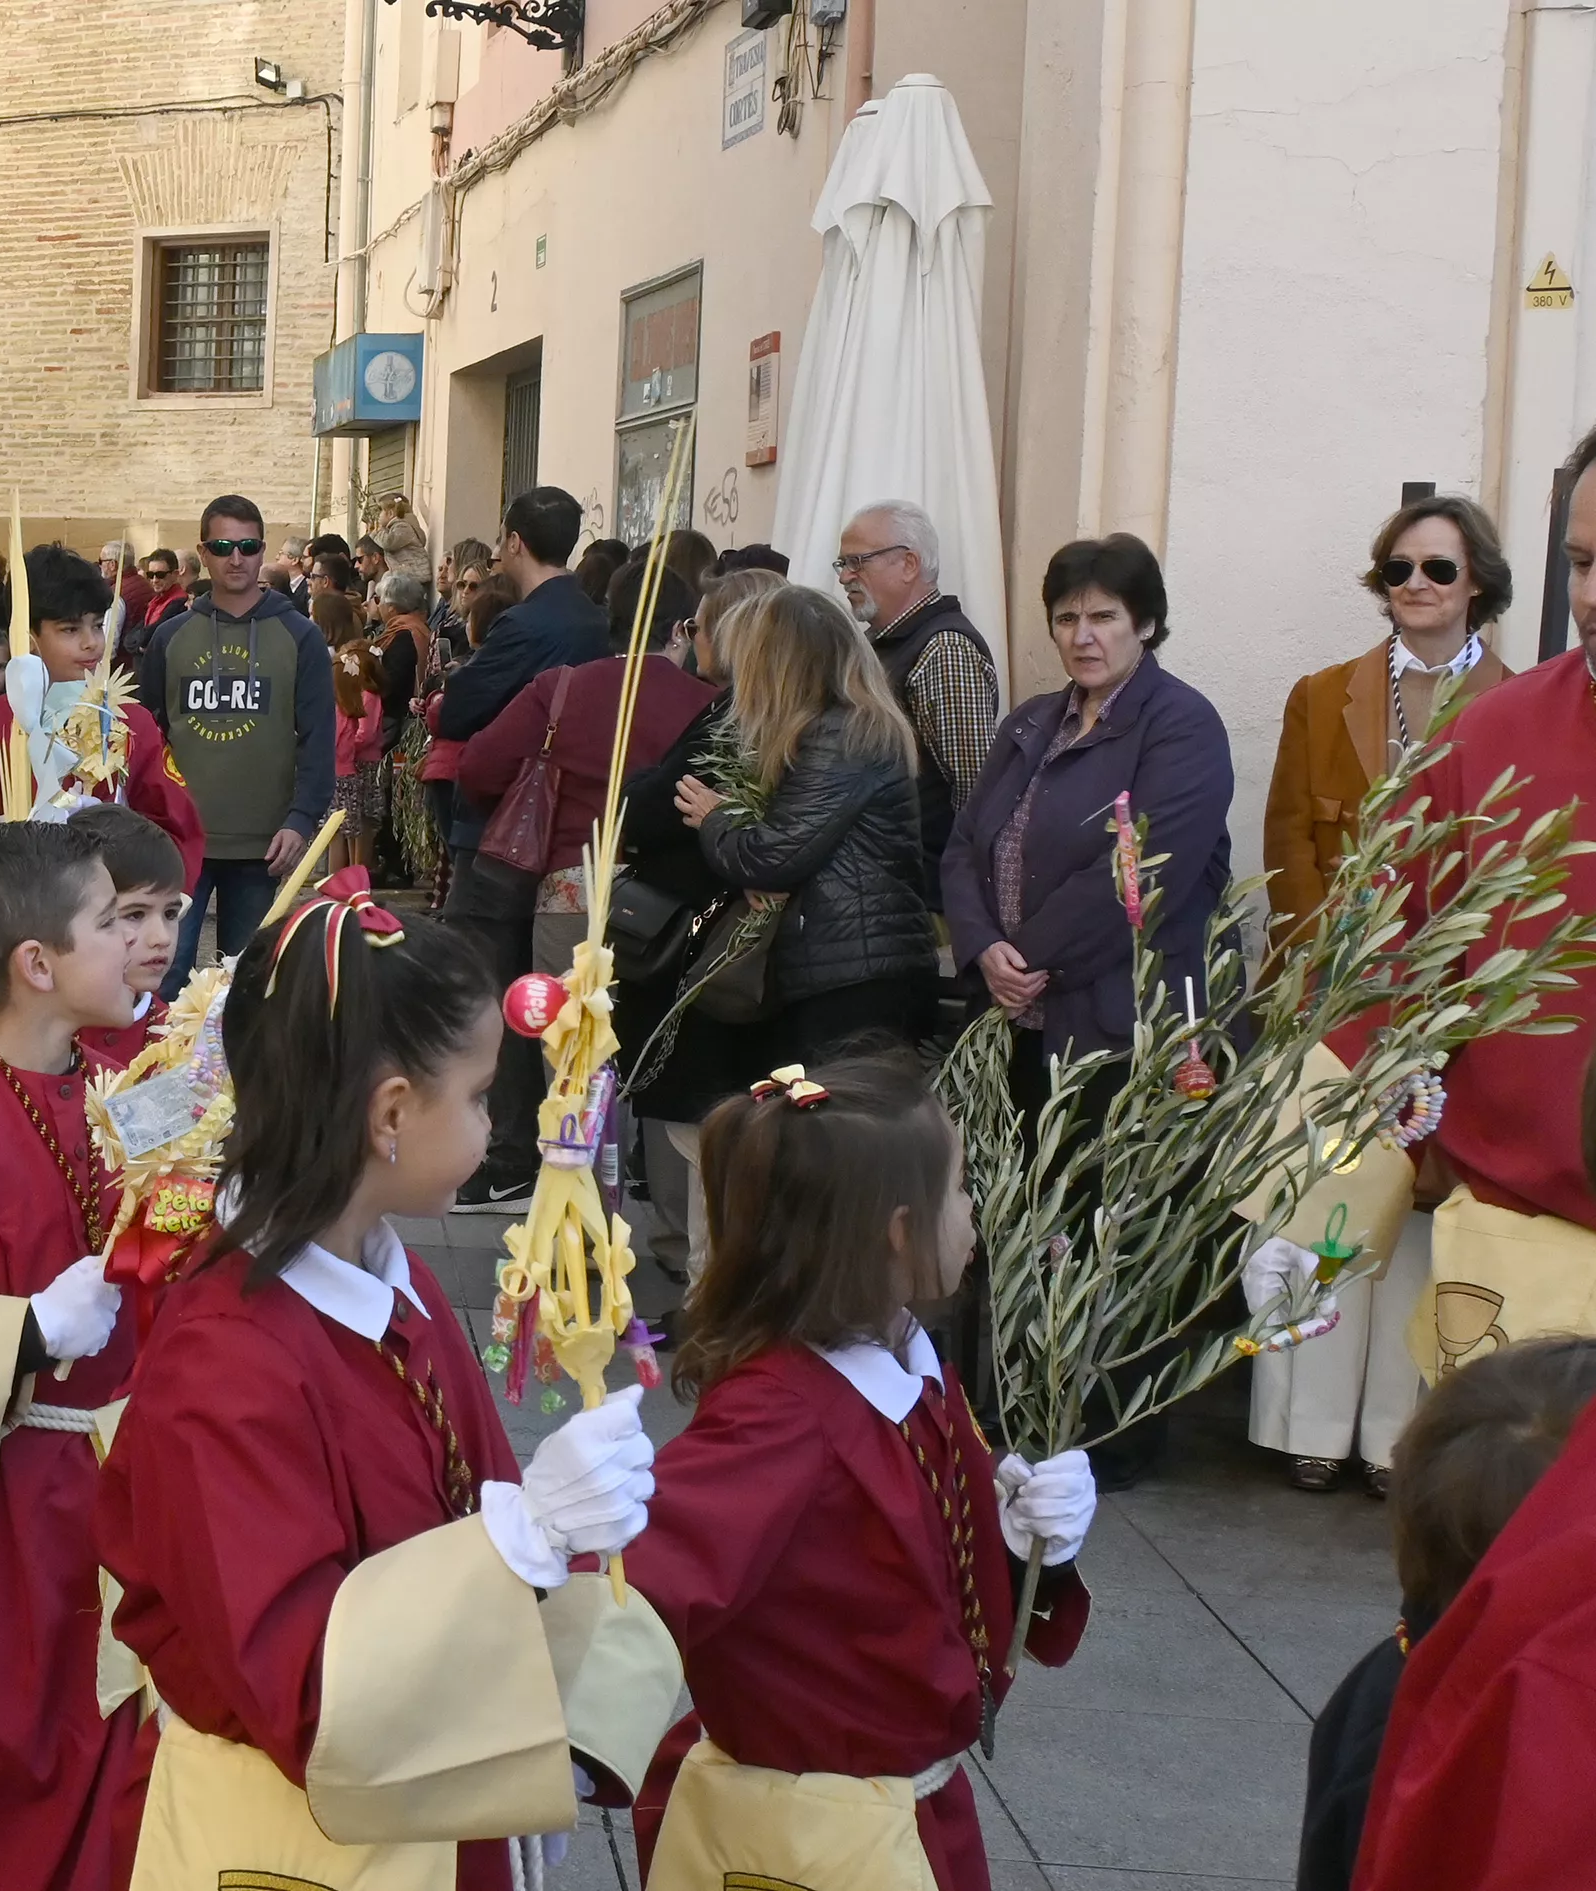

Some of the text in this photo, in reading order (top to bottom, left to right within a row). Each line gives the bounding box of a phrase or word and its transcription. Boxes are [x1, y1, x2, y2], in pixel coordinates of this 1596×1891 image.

[491, 271, 497, 313] 2
[1533, 295, 1568, 307] 380 V
[187, 680, 261, 710] CO-RE
